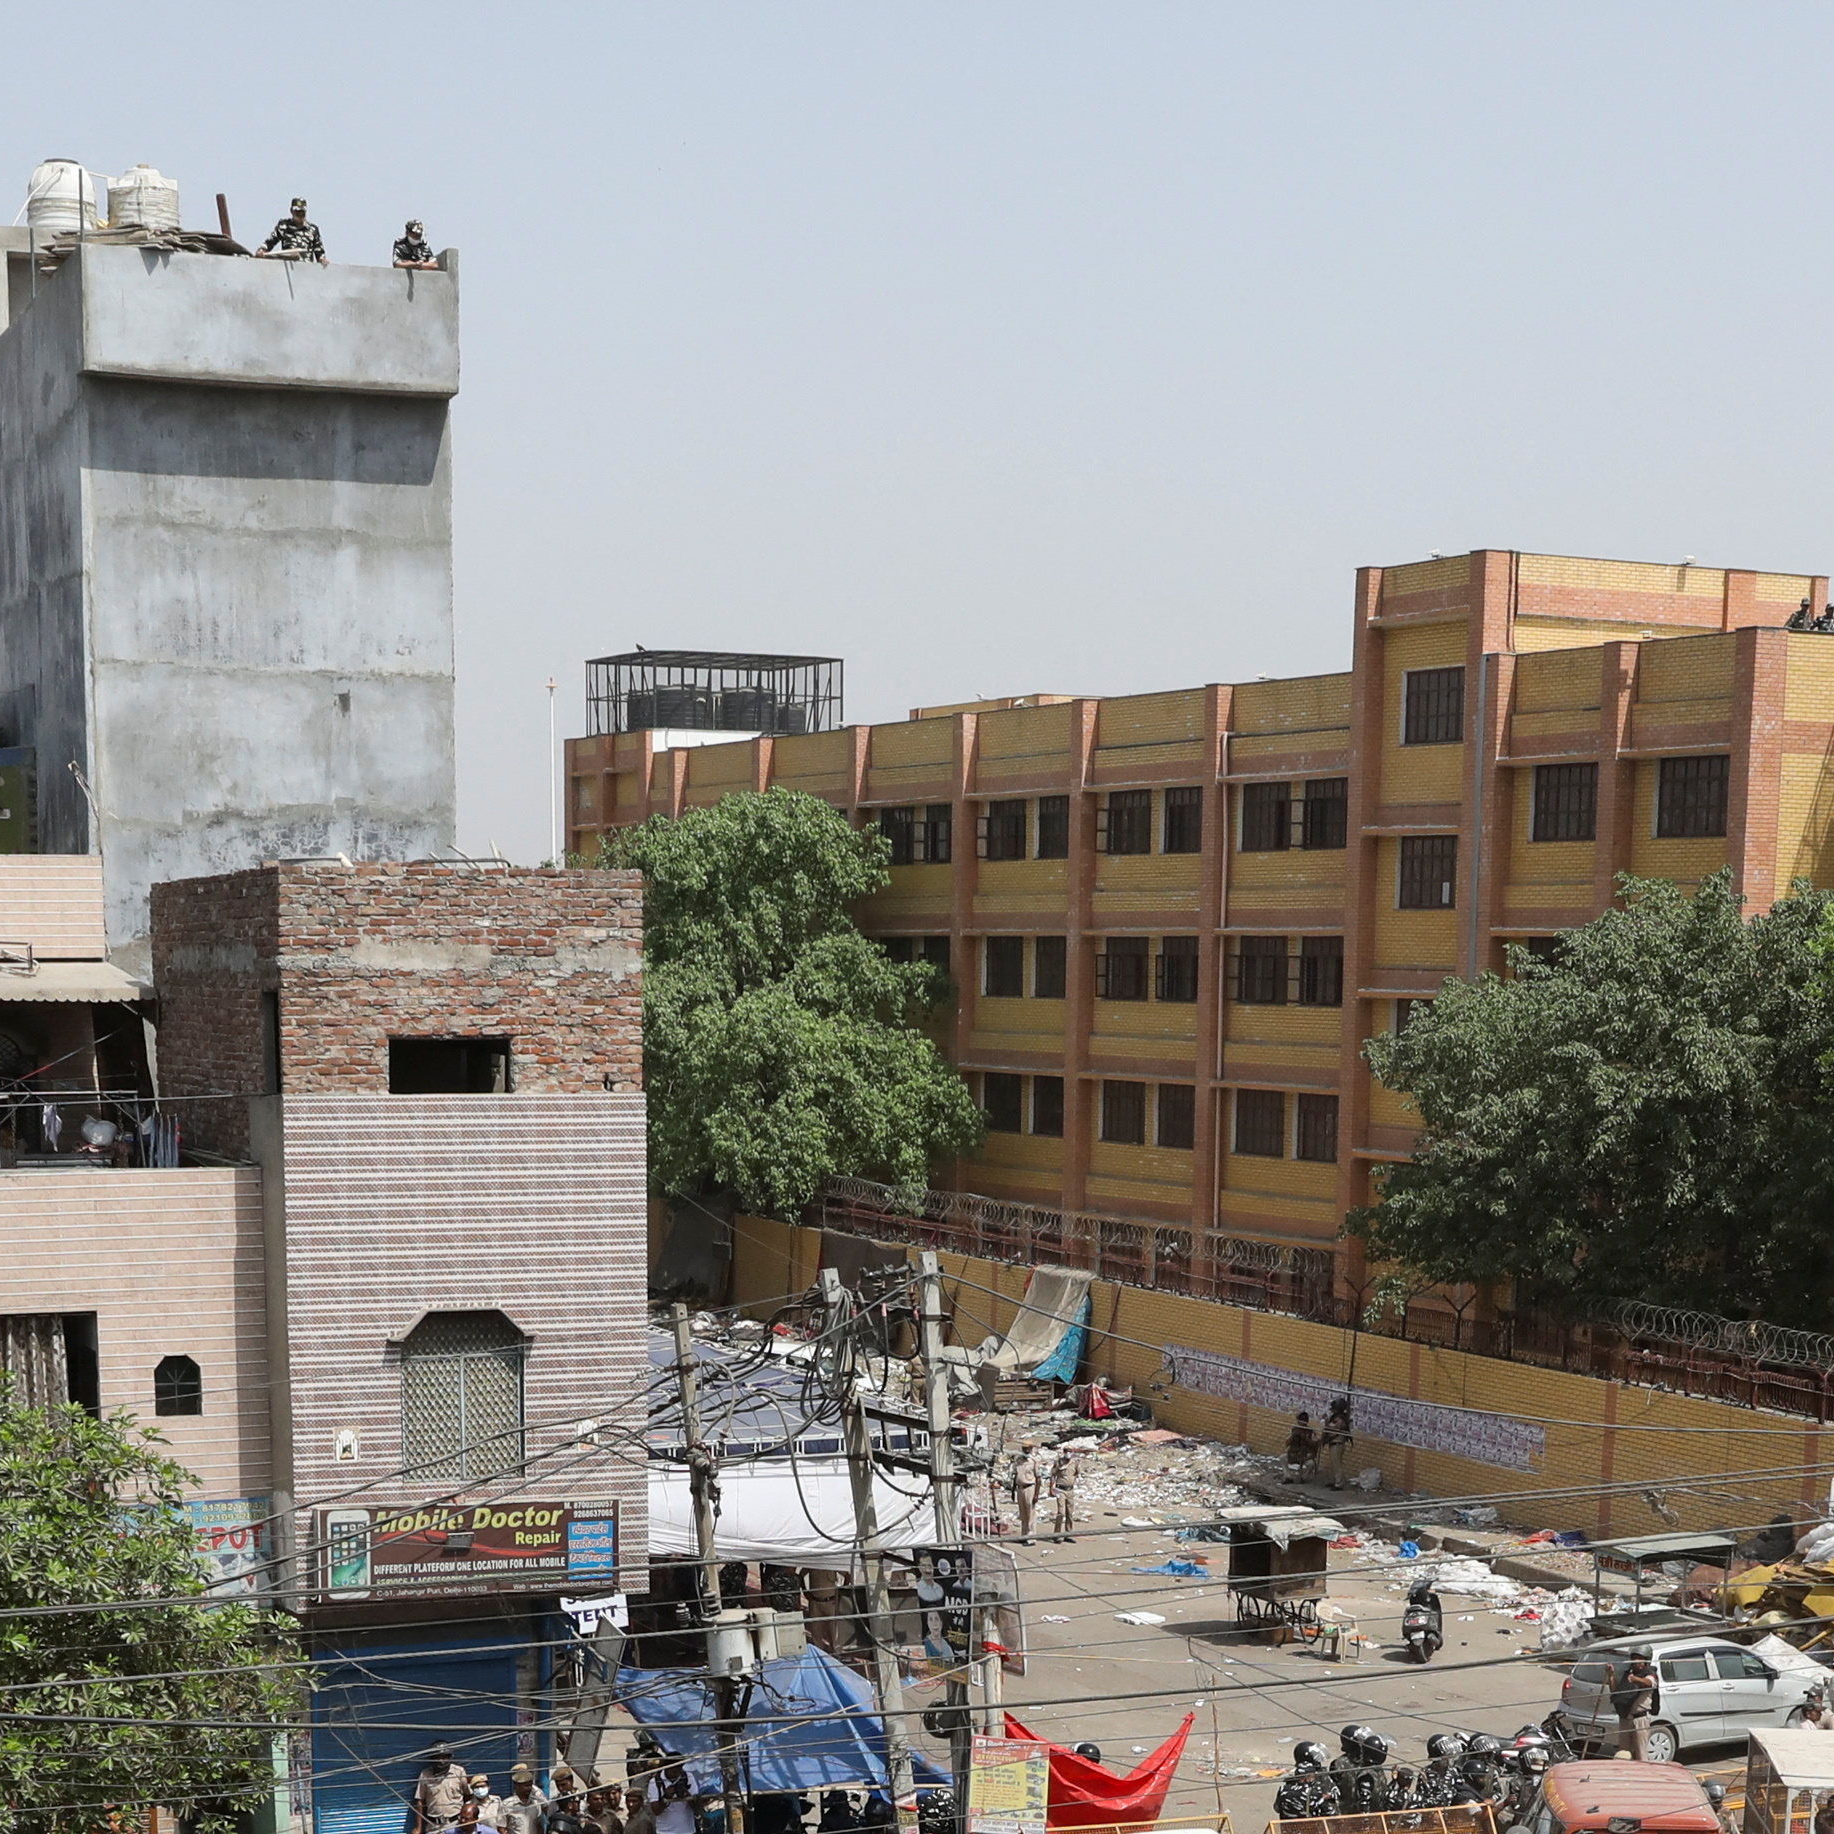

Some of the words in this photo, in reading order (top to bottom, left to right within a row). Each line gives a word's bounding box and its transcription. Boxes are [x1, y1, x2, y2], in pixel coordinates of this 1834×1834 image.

[374, 1508, 464, 1533] Mobile
[472, 1506, 564, 1529] Doctor
[515, 1530, 562, 1547] Repair
[374, 1563, 412, 1575] DIFFERENT
[414, 1562, 455, 1573] PLATEFORM
[457, 1561, 471, 1571] ONE
[473, 1559, 508, 1570] LOCATION
[509, 1558, 523, 1569] FOR
[524, 1557, 538, 1568] ALL
[539, 1556, 566, 1567] MOBILE
